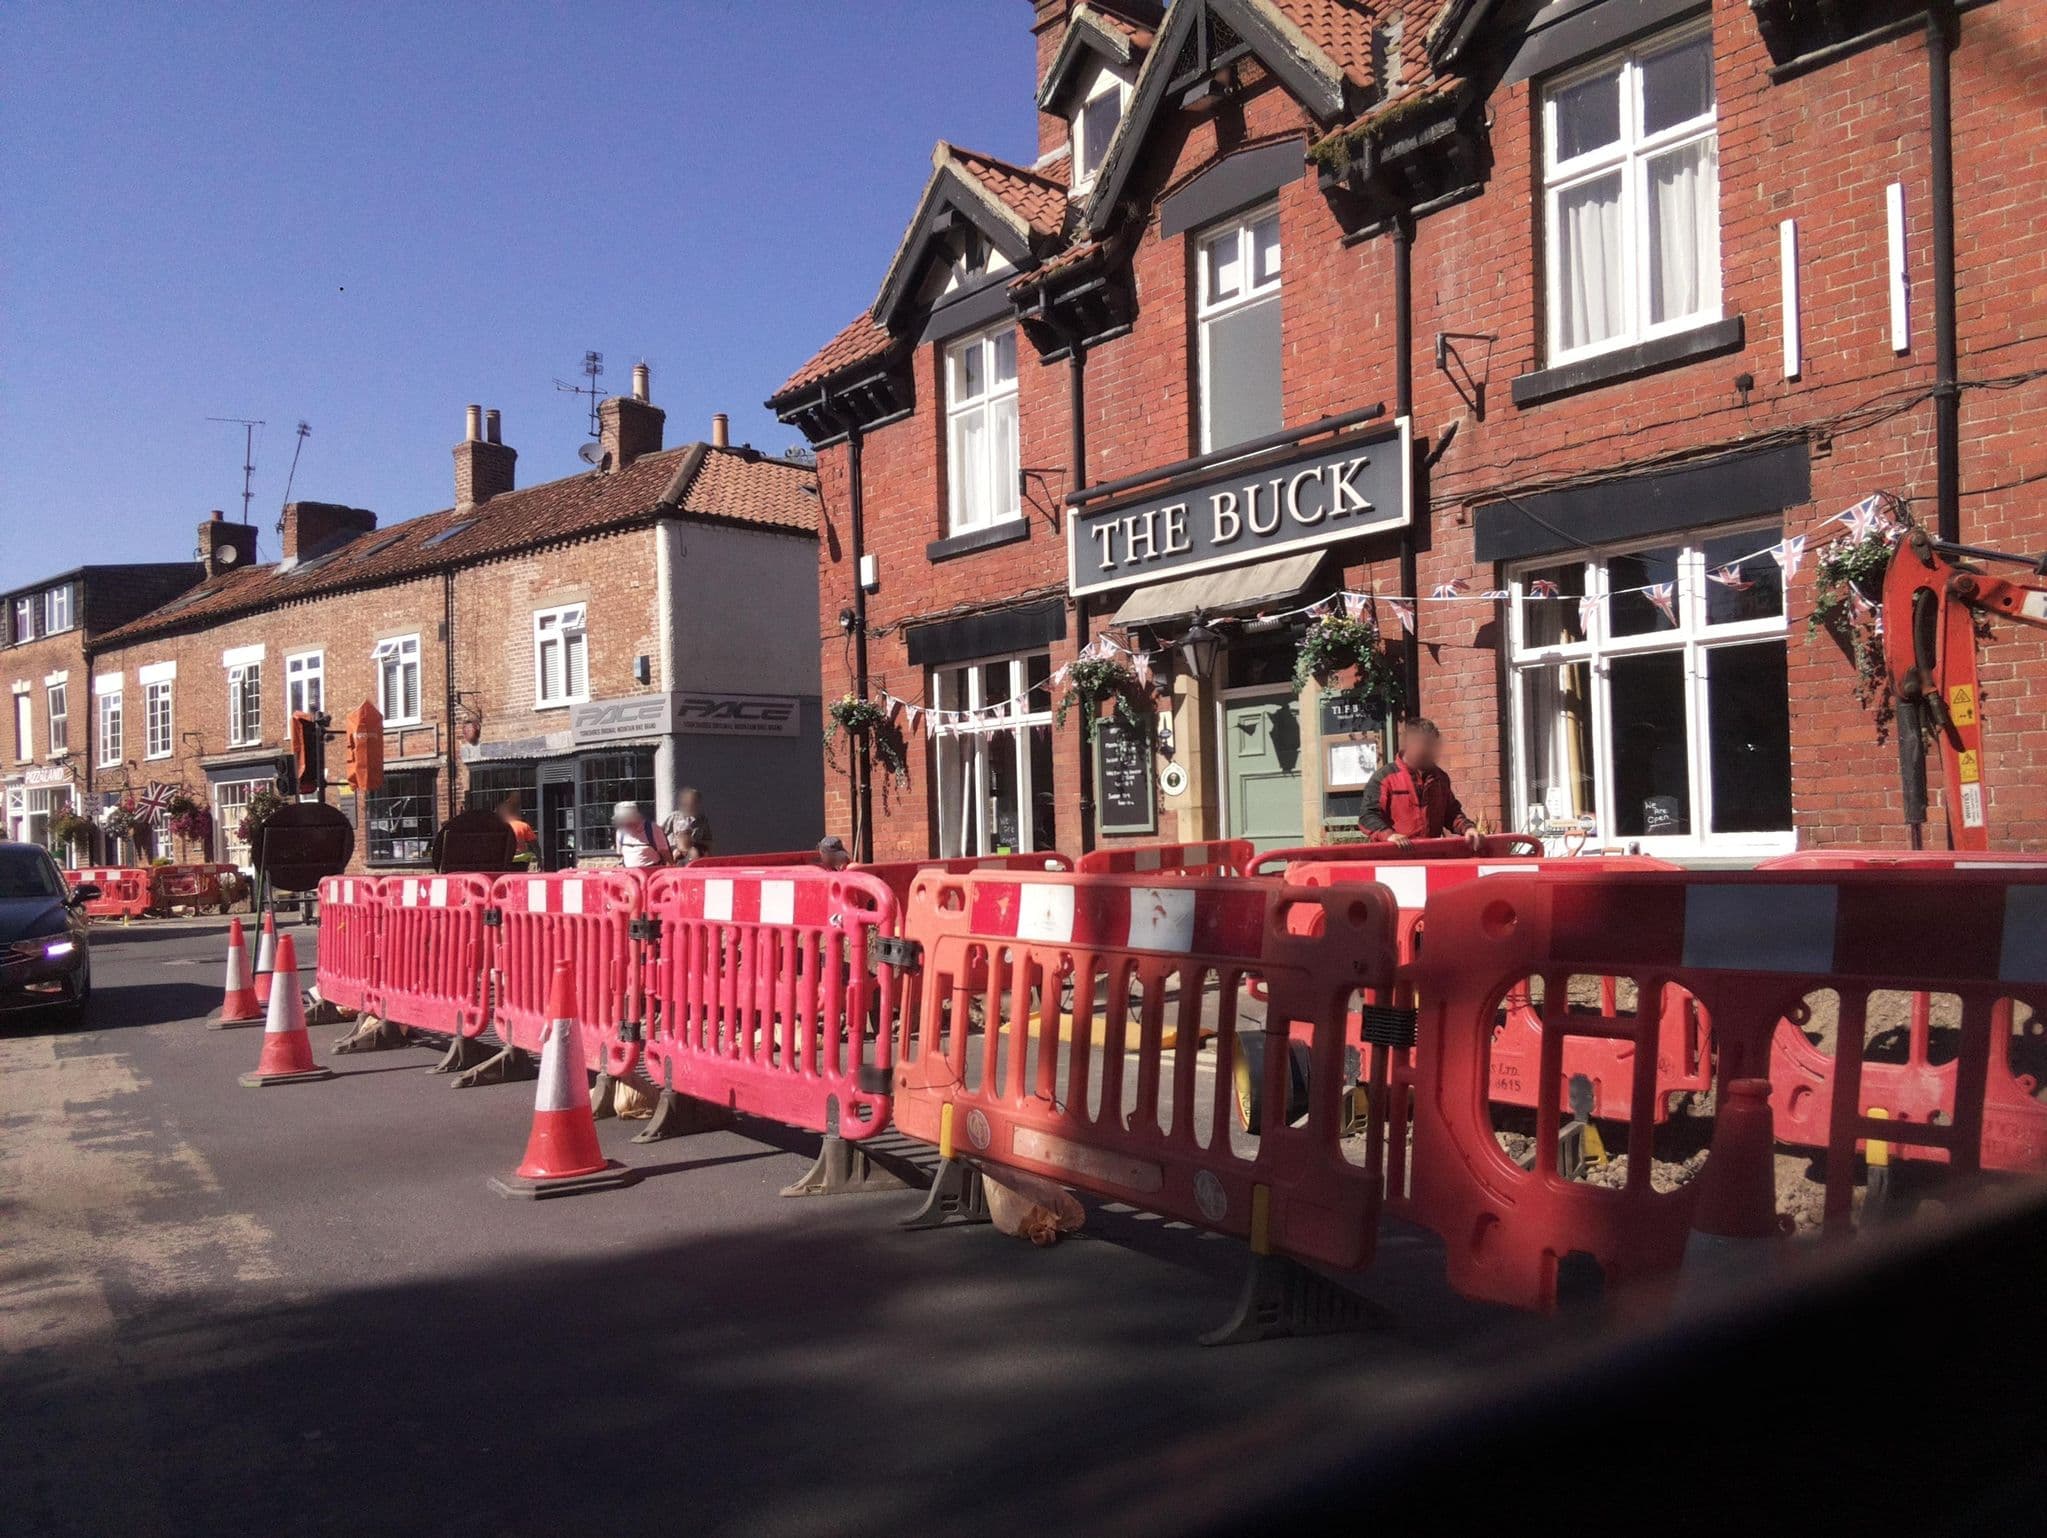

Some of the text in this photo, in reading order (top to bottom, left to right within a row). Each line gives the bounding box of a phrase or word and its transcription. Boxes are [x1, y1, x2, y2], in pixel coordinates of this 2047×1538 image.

[1091, 456, 1373, 569] THE BUCK
[575, 698, 666, 728] PACE
[677, 699, 795, 720] PACE
[1647, 814, 1670, 824] Open
